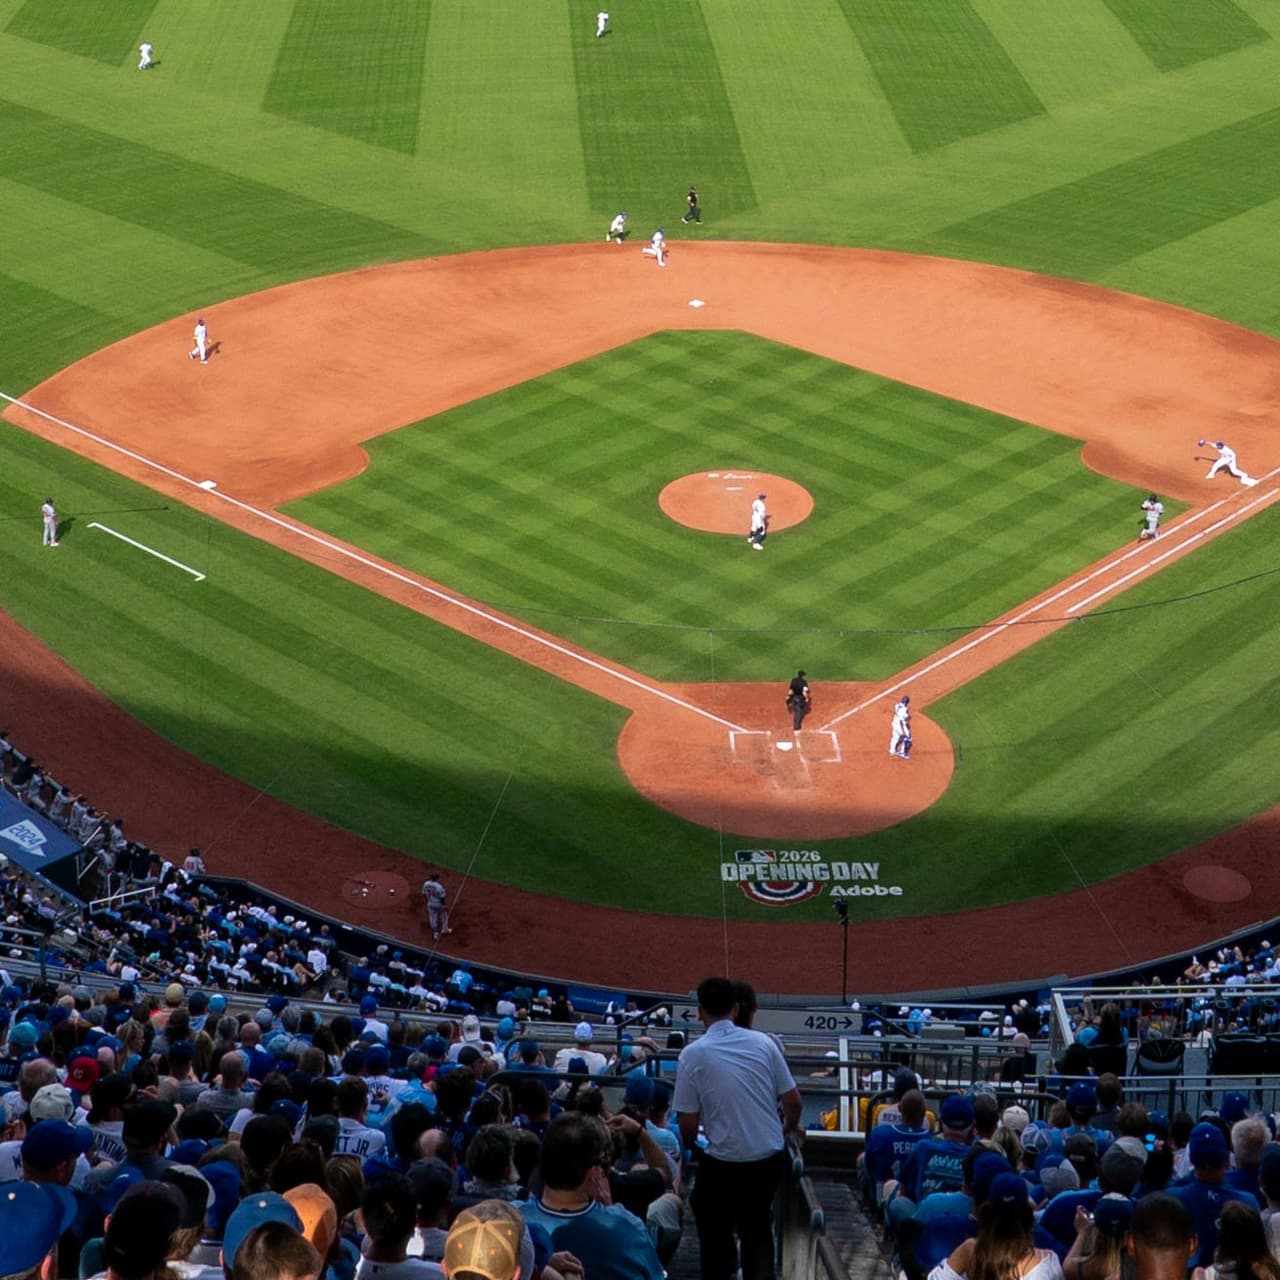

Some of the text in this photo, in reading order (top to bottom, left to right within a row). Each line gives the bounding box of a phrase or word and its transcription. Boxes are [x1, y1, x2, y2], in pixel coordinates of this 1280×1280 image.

[779, 850, 821, 863] 2026
[720, 862, 881, 881] OPENING DAY
[829, 884, 904, 897] Adobe
[803, 1015, 838, 1031] 420
